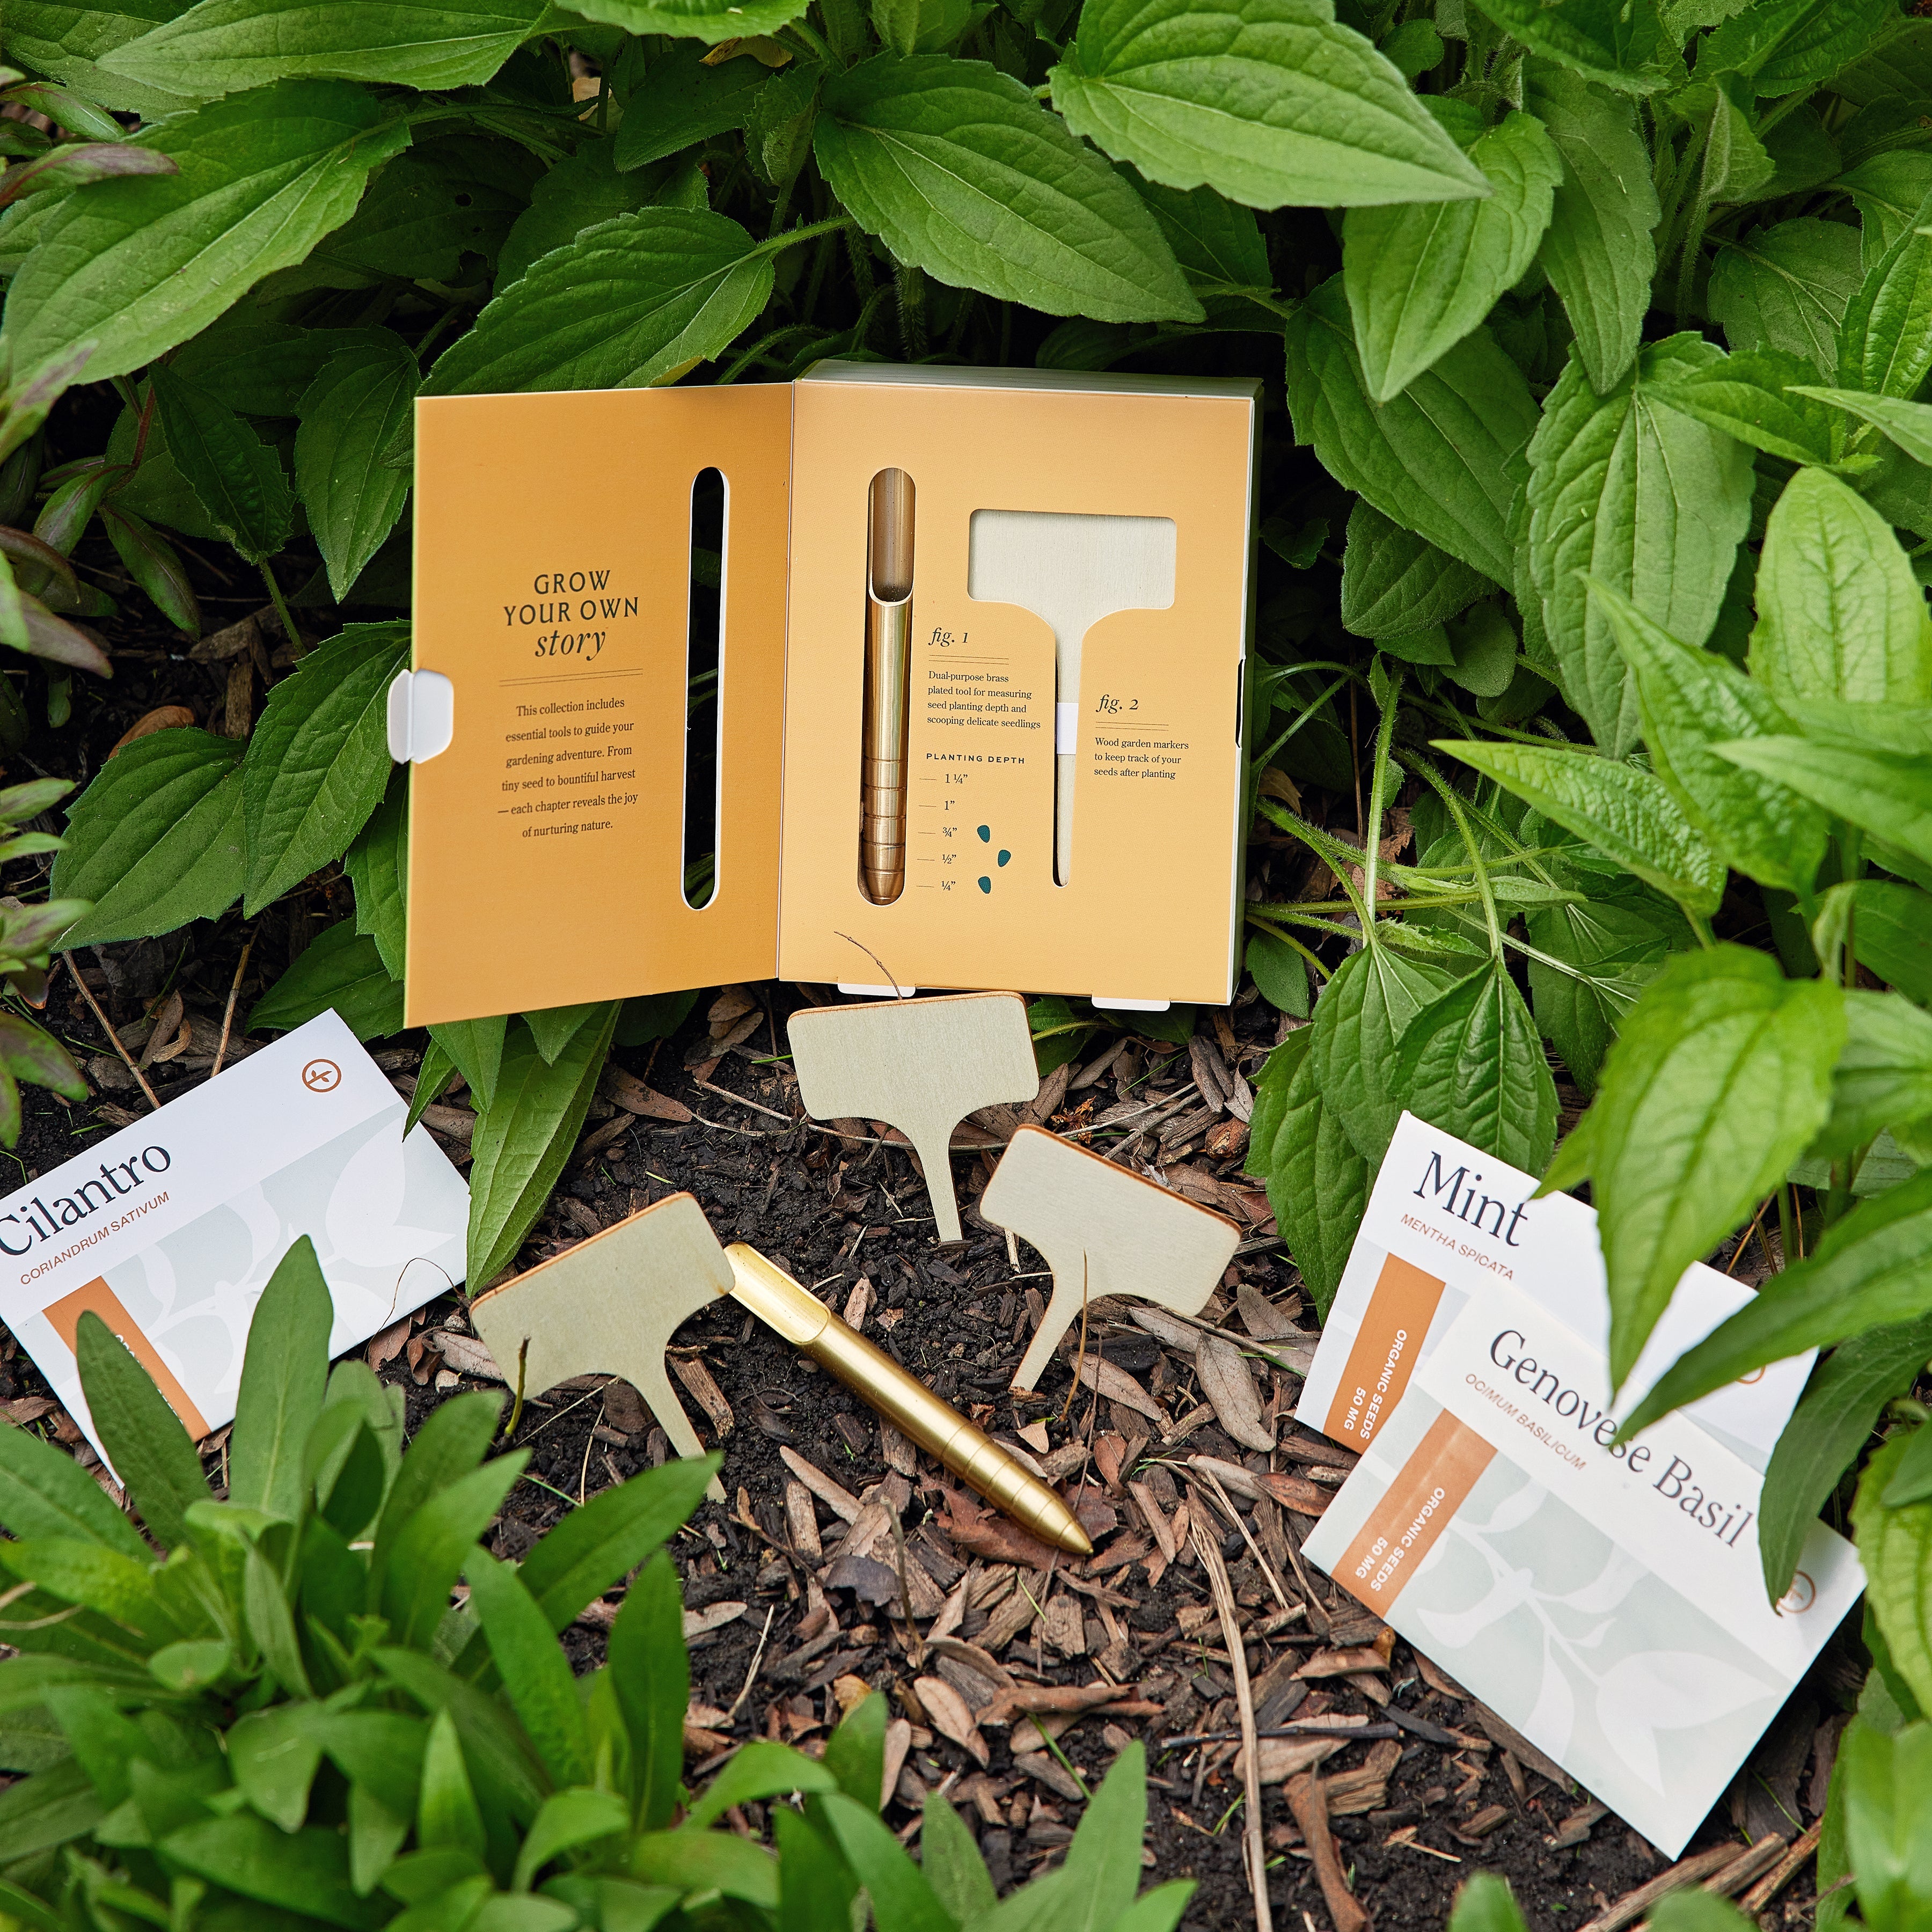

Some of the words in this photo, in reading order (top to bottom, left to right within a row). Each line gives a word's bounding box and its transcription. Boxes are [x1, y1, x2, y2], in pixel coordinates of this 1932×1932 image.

[535, 570, 610, 594] GROW
[504, 602, 570, 626] YOUR
[581, 597, 638, 620] OWN
[535, 630, 605, 661] story
[928, 627, 955, 647] fig.
[962, 633, 968, 643] 1
[928, 671, 984, 682] Dual-purpose
[987, 674, 1009, 682] brass
[928, 686, 953, 695] plated
[988, 690, 1032, 699] measuring
[1096, 694, 1123, 714] fig.
[1129, 699, 1139, 709] 2
[516, 705, 537, 716] This
[539, 702, 583, 714] collection
[587, 698, 625, 710] includes
[927, 701, 946, 709] seed
[949, 701, 983, 712] planting
[985, 703, 1008, 713] depth
[506, 728, 546, 742] essential
[549, 726, 571, 737] tools
[574, 727, 582, 735] to
[585, 723, 610, 736] guide
[613, 723, 634, 734] your
[927, 716, 964, 726] scooping
[967, 717, 998, 726] delicate
[1001, 720, 1041, 729] seedlings
[1095, 737, 1118, 746] Wood
[1121, 740, 1151, 748] garden
[1154, 741, 1189, 749] markers
[506, 753, 554, 769] gardening
[557, 750, 604, 761] adventure.
[608, 746, 632, 756] From
[926, 753, 983, 762] PLANTING
[1105, 753, 1125, 763] keep
[1128, 754, 1149, 763] track
[502, 781, 519, 792] tiny
[522, 777, 543, 788] seed
[546, 778, 554, 786] to
[558, 772, 598, 785] bountiful
[601, 769, 635, 781] harvest
[1094, 768, 1118, 776] seeds
[1120, 769, 1139, 777] after
[1141, 770, 1176, 779] planting
[536, 801, 570, 812] chapter
[573, 795, 605, 808] reveals
[608, 794, 622, 804] the
[624, 793, 638, 804] joy
[522, 827, 532, 837] of
[534, 823, 579, 836] nurturing
[581, 821, 612, 831] nature.
[0, 1145, 171, 1256] Cilantro
[1413, 1151, 1528, 1246] Mint
[20, 1226, 110, 1285] CORIANDRUM
[111, 1191, 170, 1232] SATIVUM
[1401, 1213, 1456, 1249] MENTHA
[1459, 1245, 1514, 1280] SPICATA
[1377, 1329, 1407, 1393] ORGANIC
[1352, 1387, 1366, 1406] 50
[1344, 1407, 1359, 1430] MG
[1360, 1393, 1383, 1439] SEEDS
[1465, 1373, 1518, 1418] OCIMUM
[1517, 1414, 1587, 1471] BASILICUM
[1652, 1455, 1754, 1548] Basil
[1401, 1487, 1445, 1548] ORGANIC
[1372, 1536, 1388, 1556] 50
[1355, 1555, 1375, 1579] MG
[1370, 1546, 1405, 1592] SEEDS
